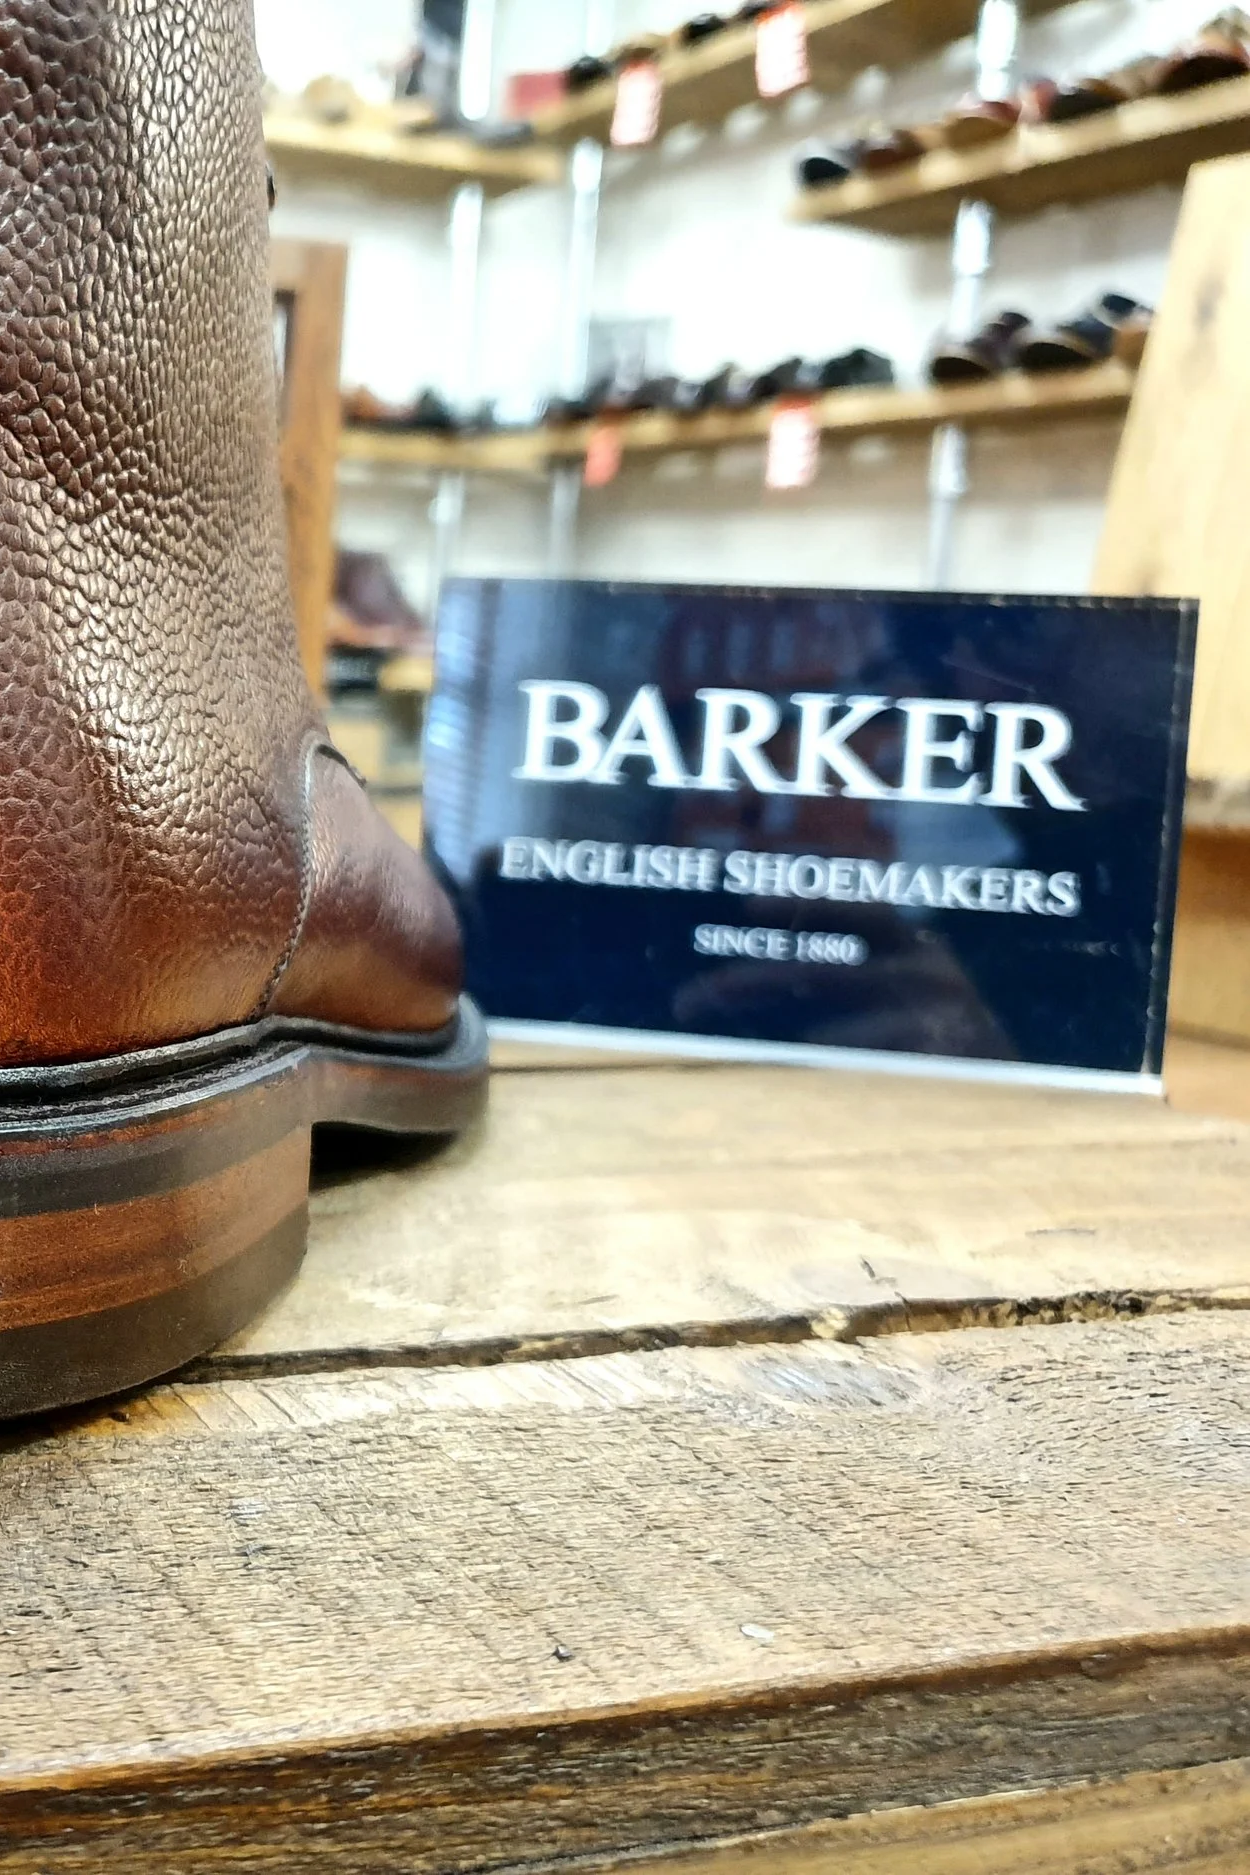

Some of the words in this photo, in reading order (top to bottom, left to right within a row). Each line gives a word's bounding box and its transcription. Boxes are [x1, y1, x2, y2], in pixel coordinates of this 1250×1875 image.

[513, 680, 1086, 811] BARKER
[500, 837, 718, 892] ENGLISH
[724, 851, 1081, 917] SHOEMAKERS
[695, 924, 791, 961] SINCE
[794, 931, 868, 966] 1880
